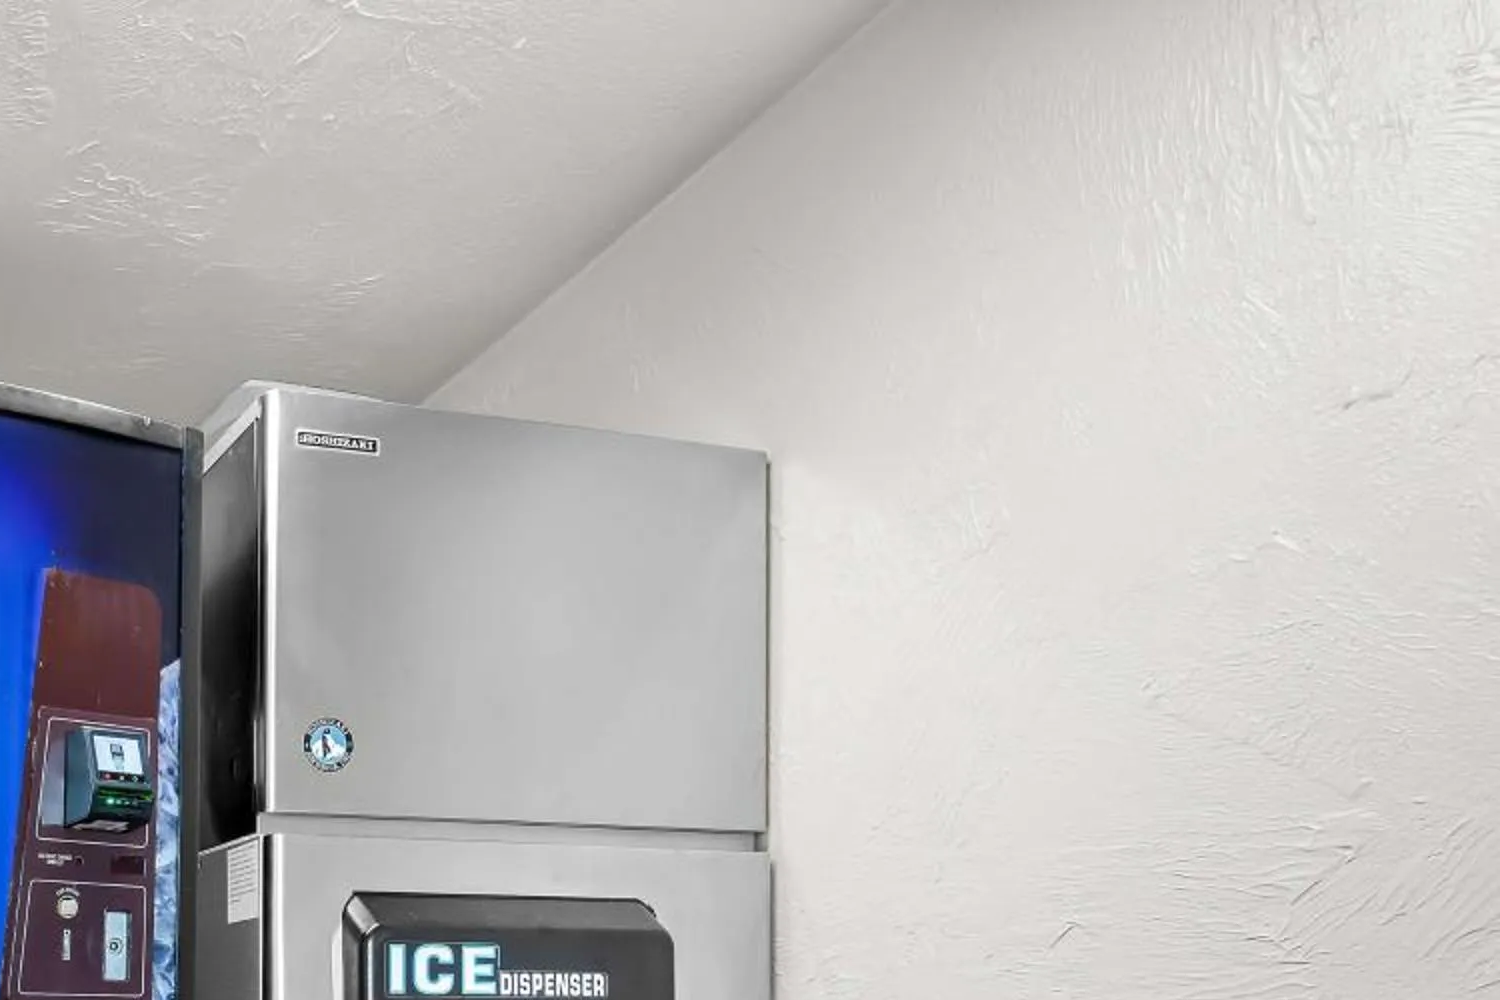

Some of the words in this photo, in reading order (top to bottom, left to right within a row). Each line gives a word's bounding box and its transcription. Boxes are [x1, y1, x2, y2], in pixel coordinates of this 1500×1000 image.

[298, 433, 377, 450] HOSHIZAKI
[388, 943, 498, 995] ICE
[499, 971, 606, 998] DISPENSER
